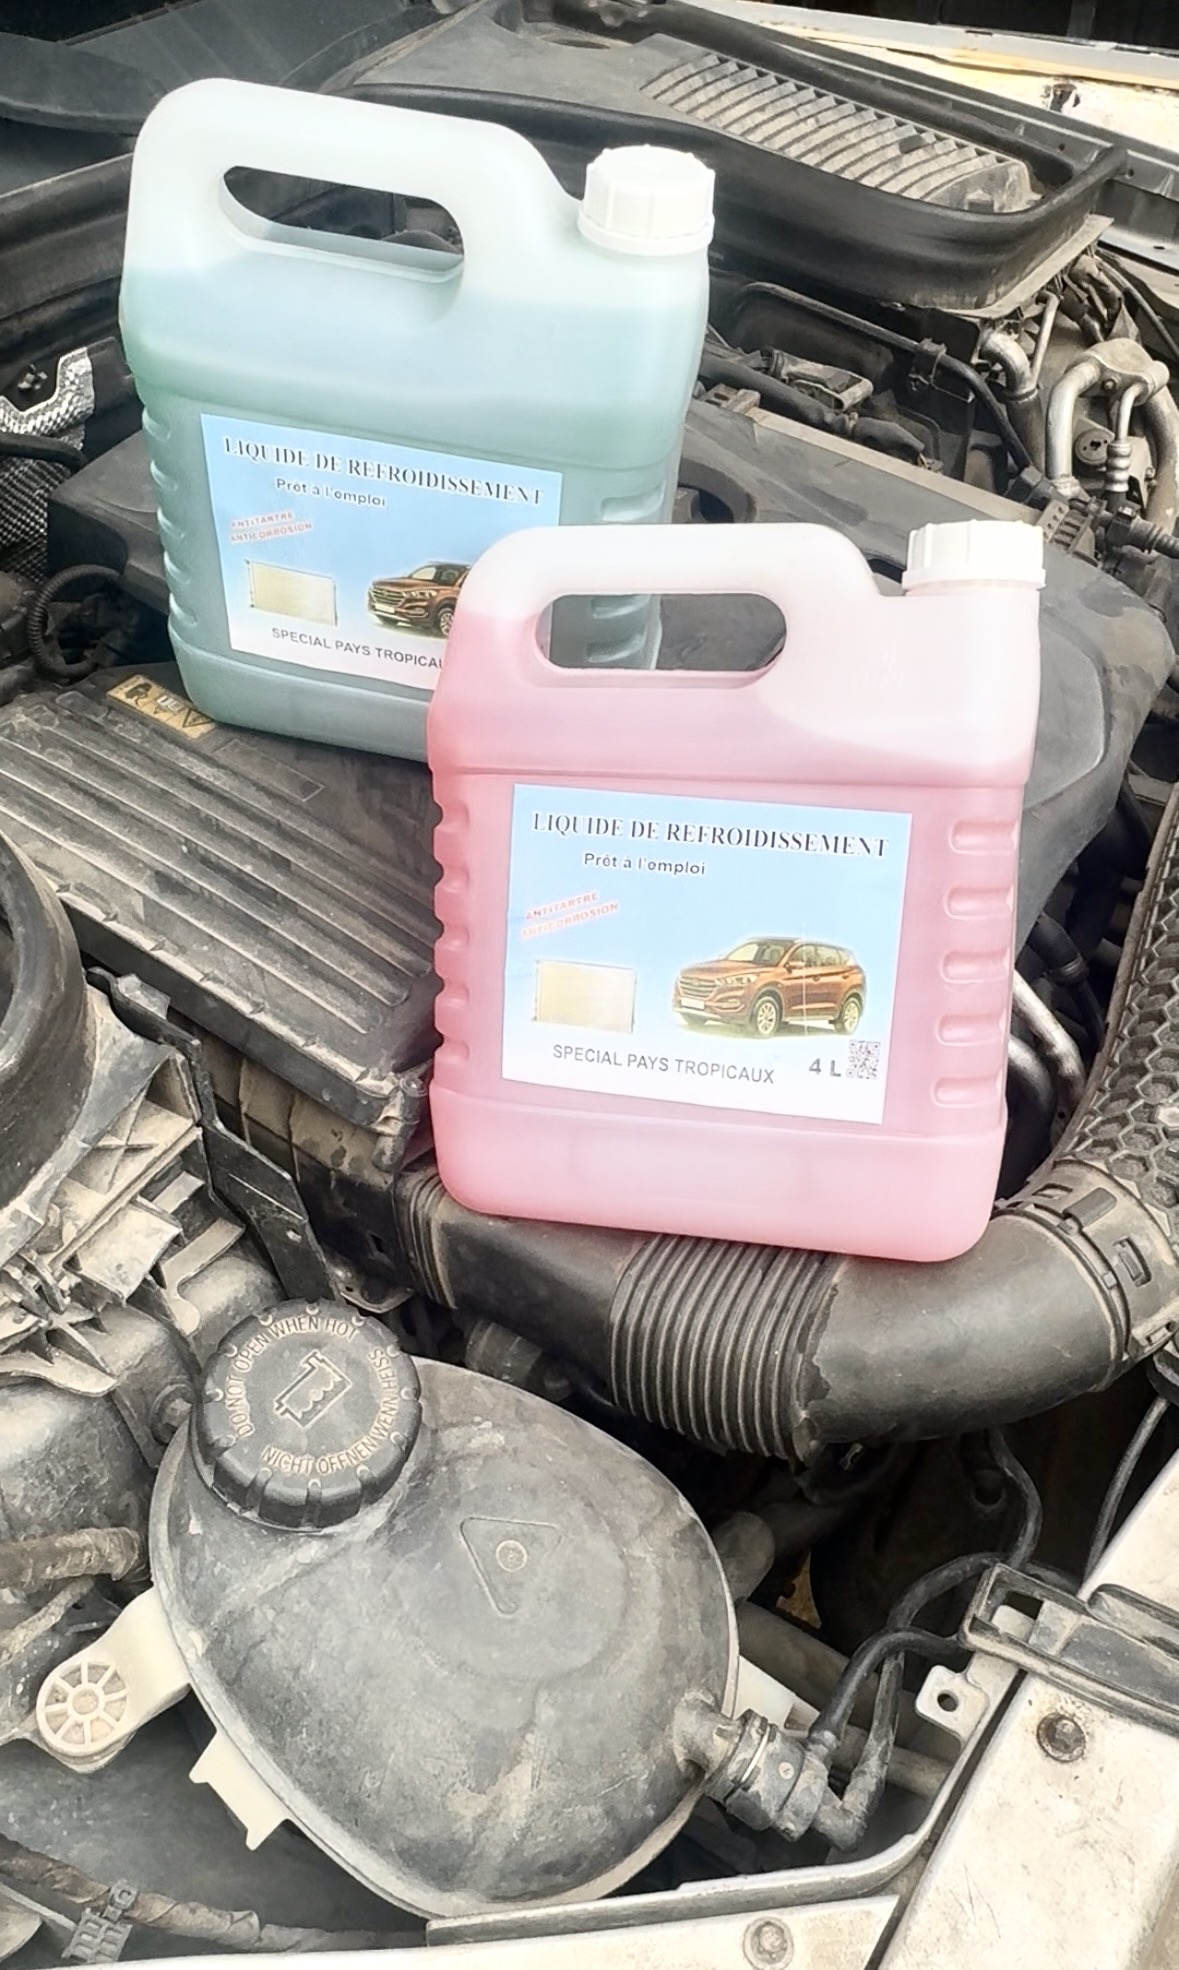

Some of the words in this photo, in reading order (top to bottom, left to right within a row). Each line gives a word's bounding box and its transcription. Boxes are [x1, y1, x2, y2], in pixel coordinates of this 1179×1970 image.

[225, 438, 309, 467] LIQUIDE
[316, 453, 341, 473] DE
[348, 459, 543, 505] REFROIDISSEMENT
[271, 627, 331, 650] SPECIAL
[335, 640, 371, 656] PAYS
[534, 813, 624, 836] LIQUIDE
[631, 820, 659, 839] DE
[667, 823, 889, 857] REFROIDISSEMENT
[638, 857, 706, 876] l'emploi
[526, 891, 598, 920] ANTITARTRE
[553, 1044, 622, 1066] SPECIAL
[627, 1053, 669, 1072] PAYS
[675, 1058, 775, 1084] TROPICAUX
[808, 1058, 822, 1075] 4
[829, 1060, 841, 1077] L
[270, 1315, 319, 1338] WHEN
[324, 1318, 359, 1340] HOT
[233, 1333, 271, 1372] OPEN
[368, 1347, 397, 1390] HEISS
[225, 1374, 246, 1408] NOT
[230, 1412, 254, 1438] DO
[370, 1396, 398, 1439] WENN
